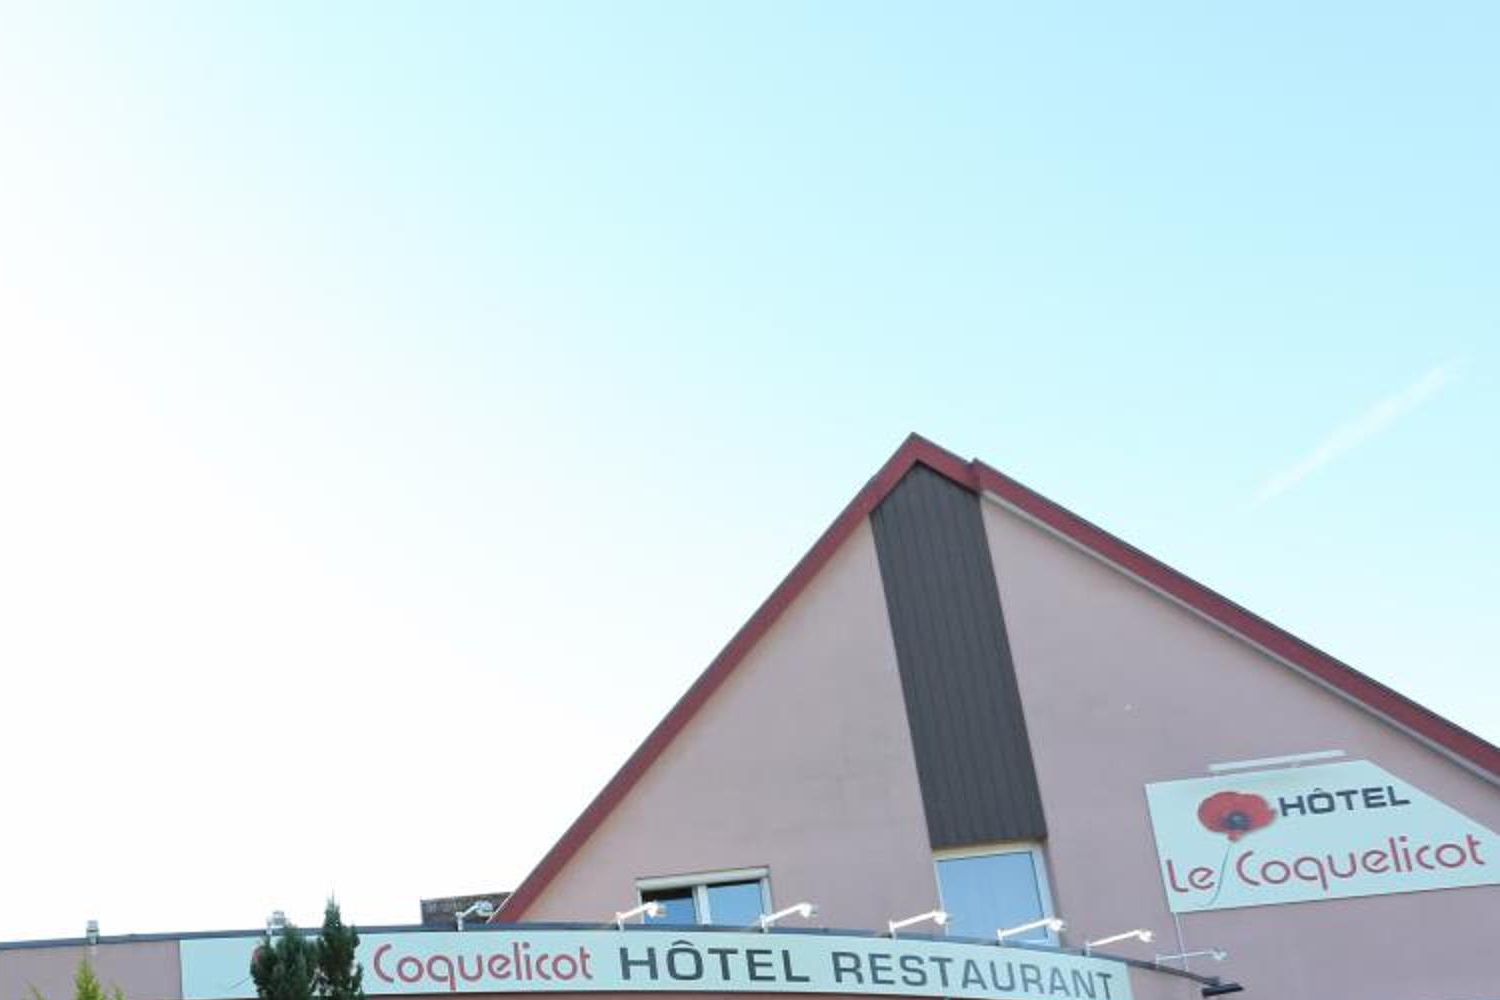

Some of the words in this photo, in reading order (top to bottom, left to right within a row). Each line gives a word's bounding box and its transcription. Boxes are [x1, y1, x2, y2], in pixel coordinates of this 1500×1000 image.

[1279, 785, 1411, 818] HÔTEL
[1166, 859, 1215, 893] Le
[1236, 833, 1485, 891] Coquelicot
[372, 941, 594, 991] Coquelicot
[620, 940, 810, 982] HÔTEL
[831, 951, 1114, 1000] RESTAURANT
